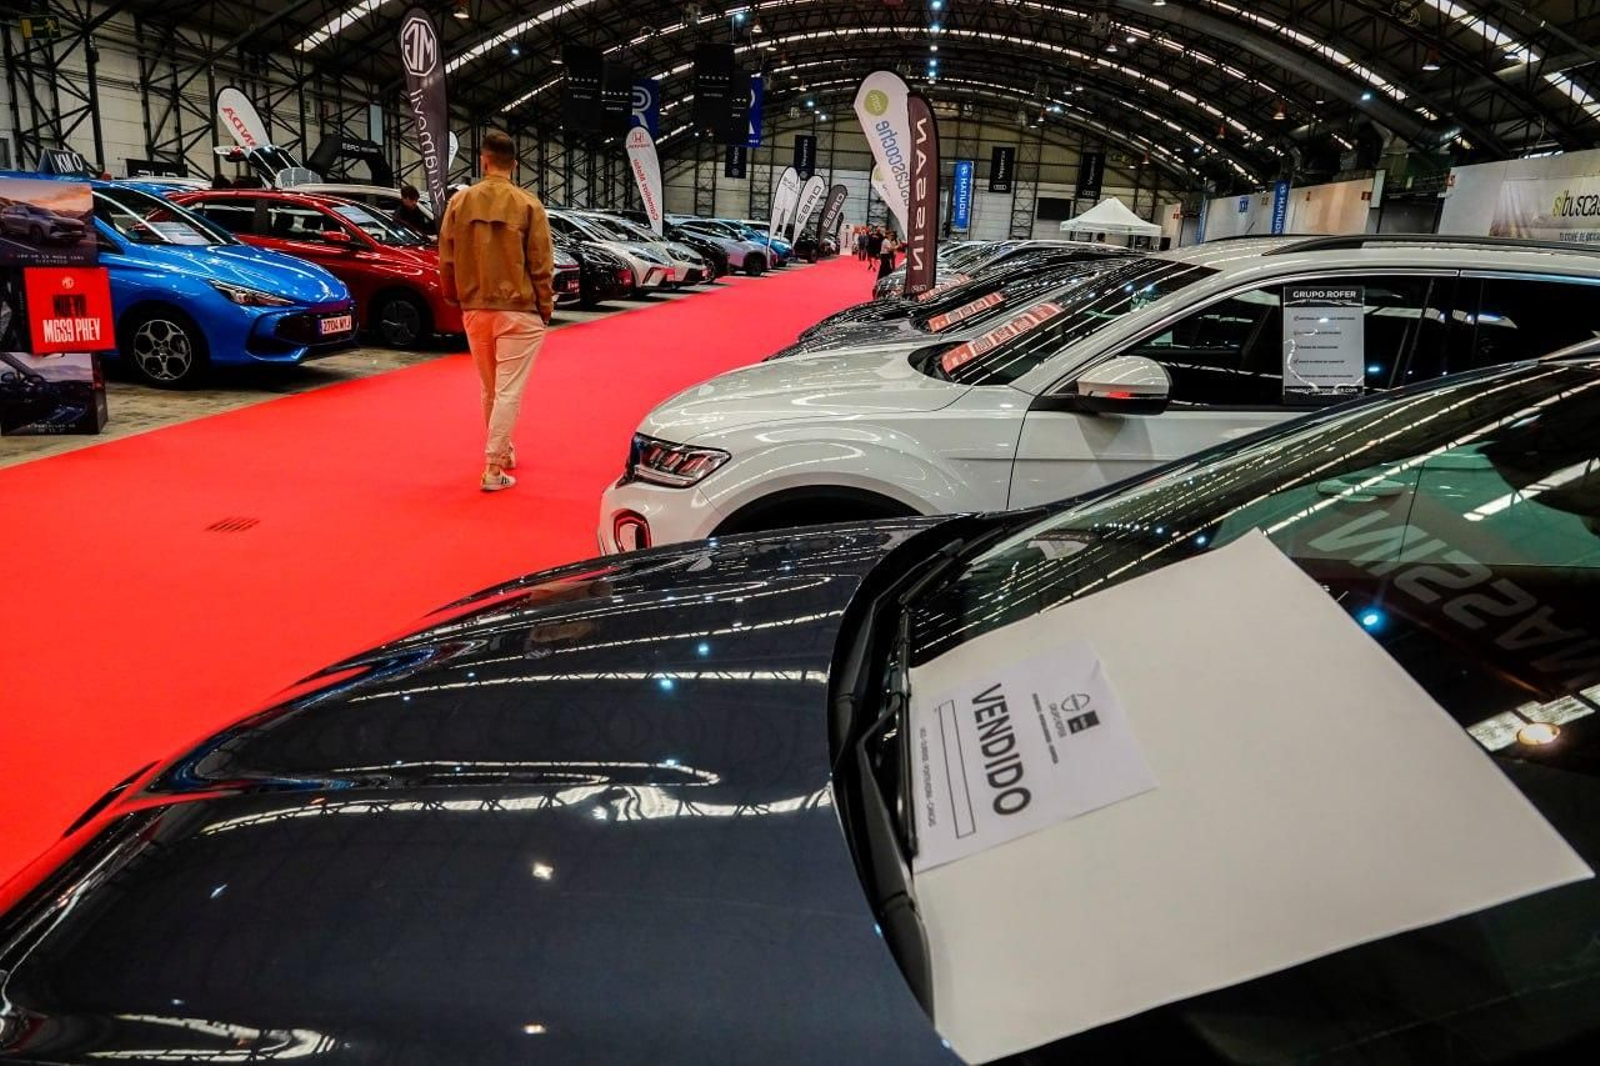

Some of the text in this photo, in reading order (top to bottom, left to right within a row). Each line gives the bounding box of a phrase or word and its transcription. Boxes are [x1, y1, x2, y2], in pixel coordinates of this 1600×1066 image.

[54, 154, 76, 173] KM
[1292, 290, 1357, 298] GRUPO ROFER
[43, 317, 100, 343] MGS9 PHEV
[971, 683, 1032, 816] VENDIDO
